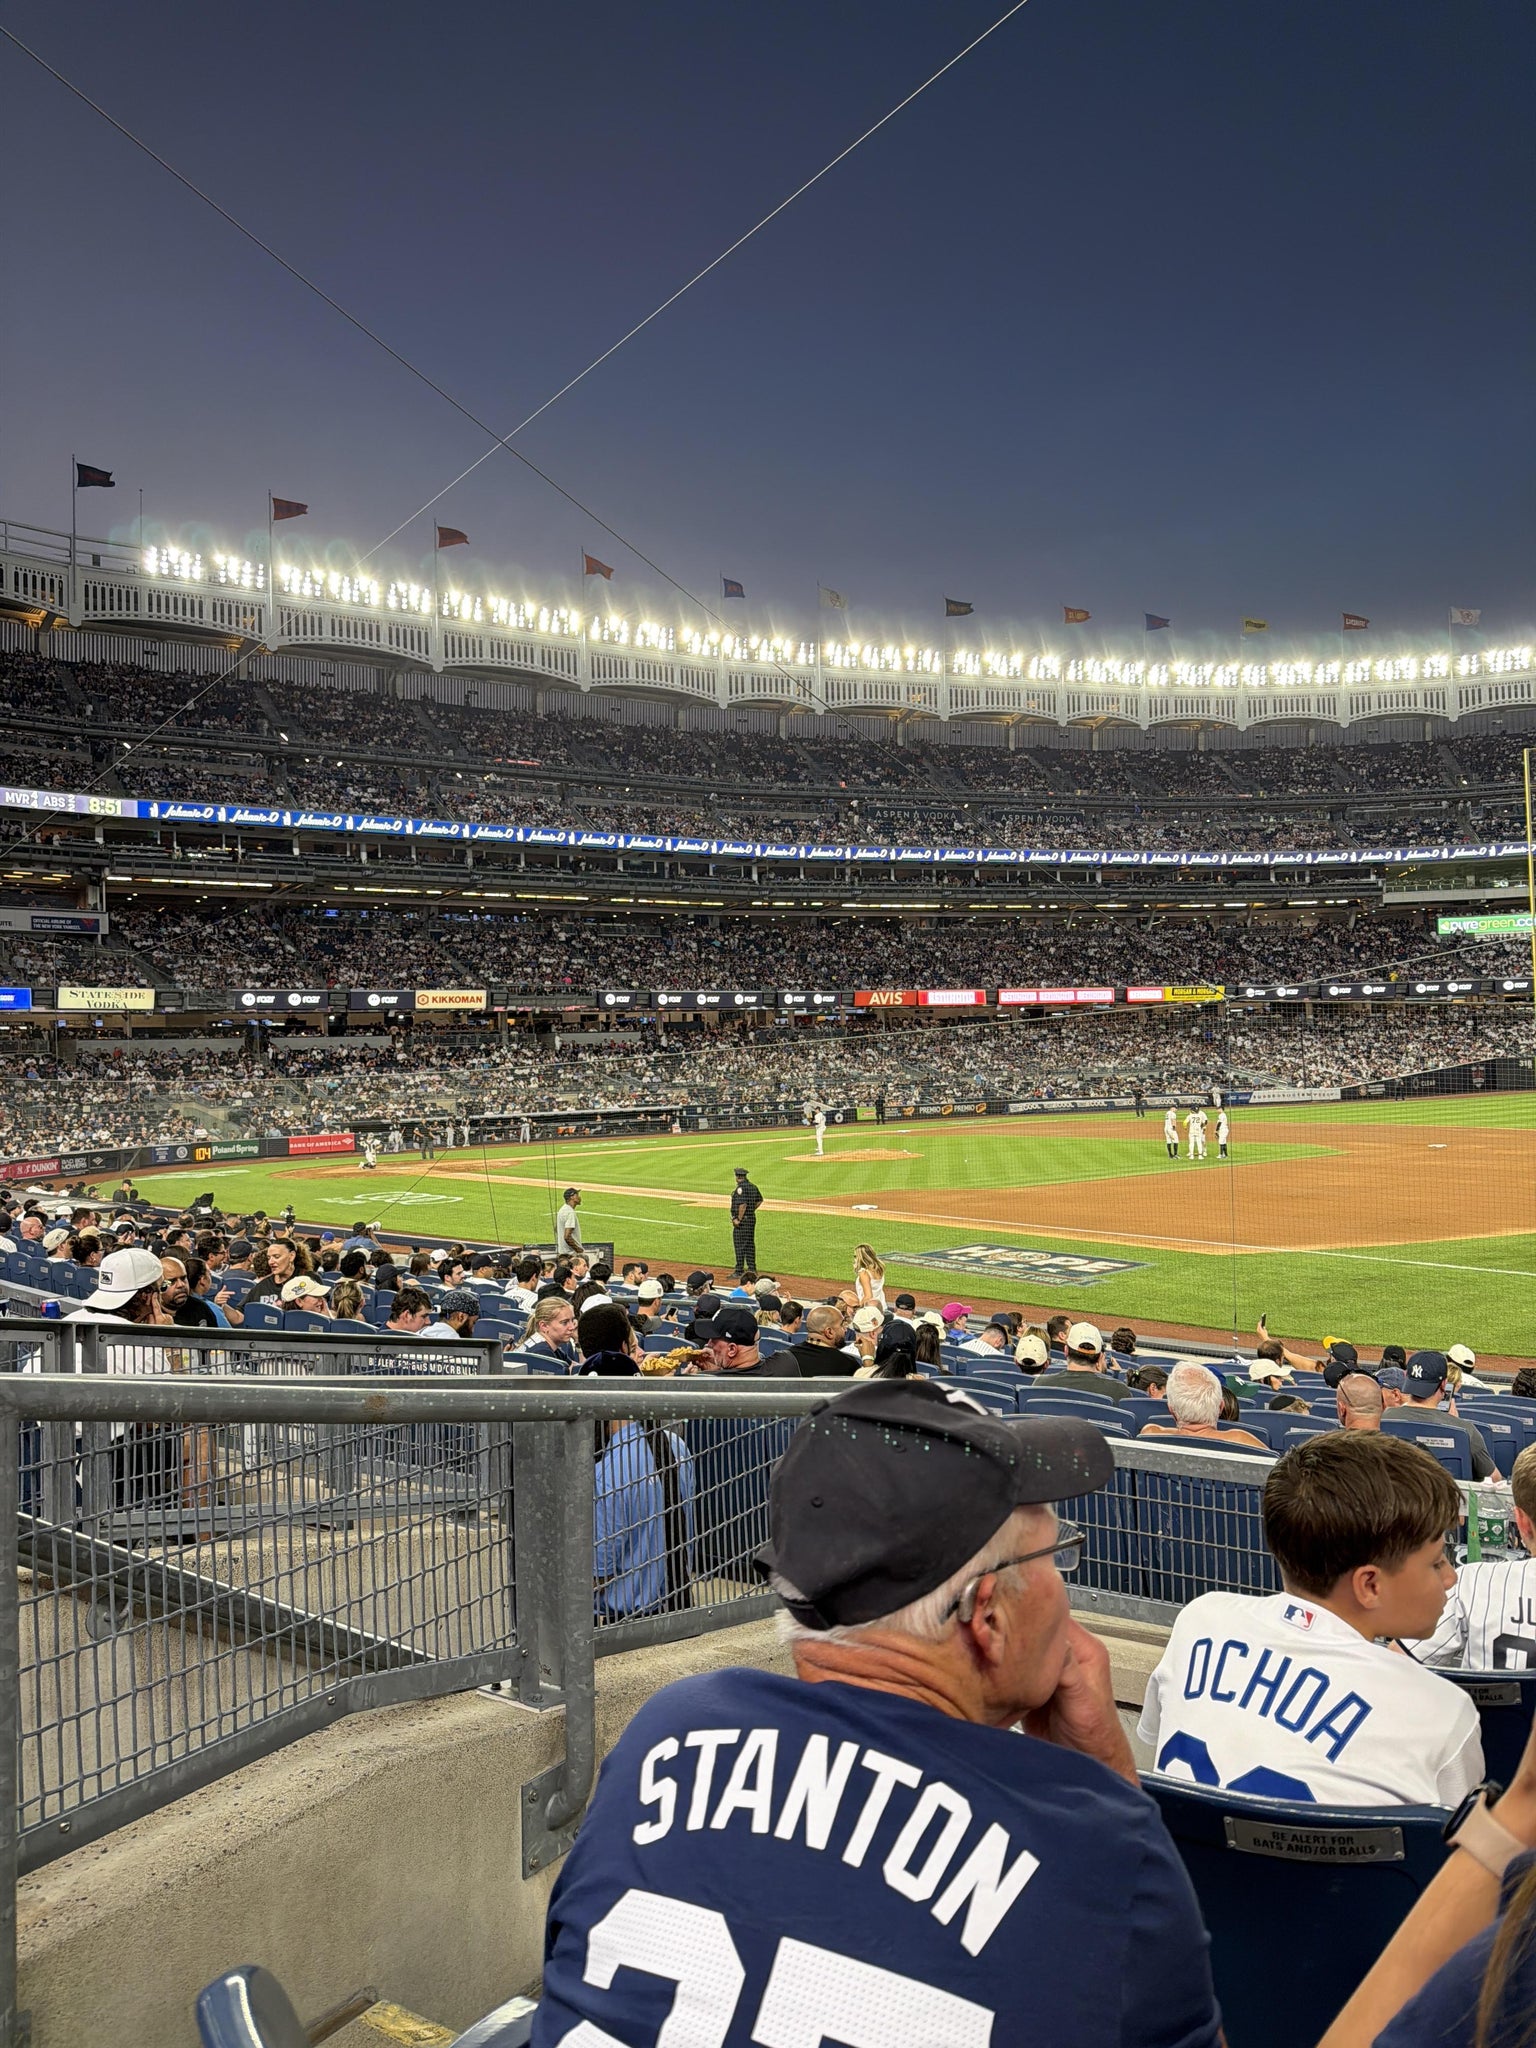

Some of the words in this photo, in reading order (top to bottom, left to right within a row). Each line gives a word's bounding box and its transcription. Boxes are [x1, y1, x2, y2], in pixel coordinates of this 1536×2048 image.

[6, 792, 29, 805] MVR
[43, 795, 65, 808] ABS
[89, 797, 122, 815] 8:51
[875, 810, 911, 819] ASPEN
[923, 812, 957, 821] VODKA
[1001, 814, 1033, 823] ASPEN
[1045, 815, 1078, 824] VODKA
[1451, 917, 1536, 934] puregreen.co
[69, 990, 145, 999] STATESIDE
[432, 995, 482, 1004] KIKKOMAN
[869, 991, 903, 1005] AVIS
[86, 1000, 128, 1009] VODKA
[919, 1106, 941, 1115] PREMIO
[954, 1104, 976, 1113] PREMIO
[195, 1147, 211, 1161] 104
[212, 1145, 236, 1155] Poland
[236, 1144, 259, 1154] Spring
[61, 1162, 87, 1170] MOWERS
[1411, 1364, 1424, 1378] NY
[1183, 1637, 1373, 1764] OCHOA
[632, 1728, 1040, 1957] STANTON
[1272, 1831, 1288, 1842] BE
[1291, 1834, 1327, 1845] ALERT
[1331, 1835, 1355, 1846] FOR
[1253, 1837, 1283, 1851] BATS
[1287, 1843, 1337, 1856] AND/OR
[1339, 1844, 1376, 1856] BALLS
